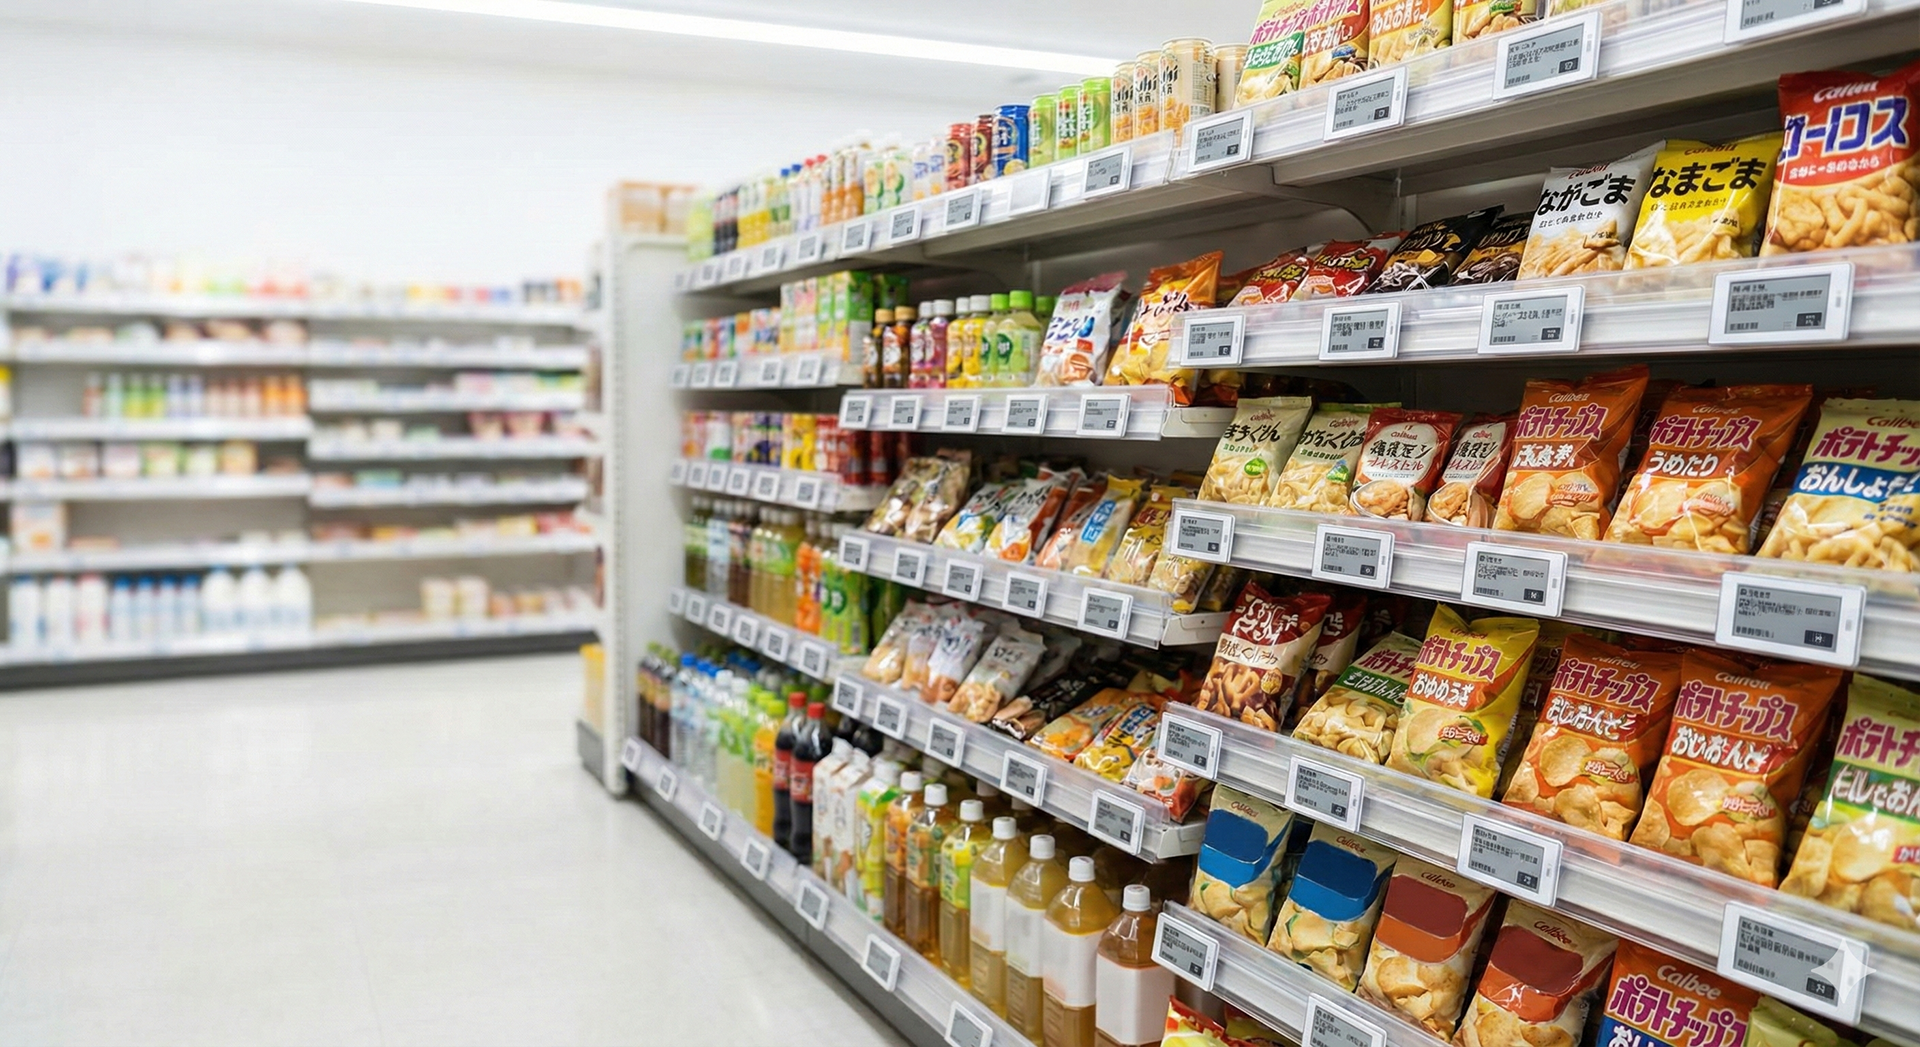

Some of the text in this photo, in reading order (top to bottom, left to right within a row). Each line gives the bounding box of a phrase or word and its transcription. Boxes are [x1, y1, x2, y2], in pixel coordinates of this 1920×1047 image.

[1537, 172, 1637, 215] ながごま
[1650, 157, 1766, 199] なまごま
[1515, 402, 1609, 440] ポテトチップス
[1649, 414, 1762, 452] ポテトチップス
[1416, 634, 1503, 683] ポテトチップス
[1551, 657, 1661, 714] ポテトチップス
[1674, 679, 1799, 742] ポテトチップス
[1657, 965, 1722, 1000] Calbee
